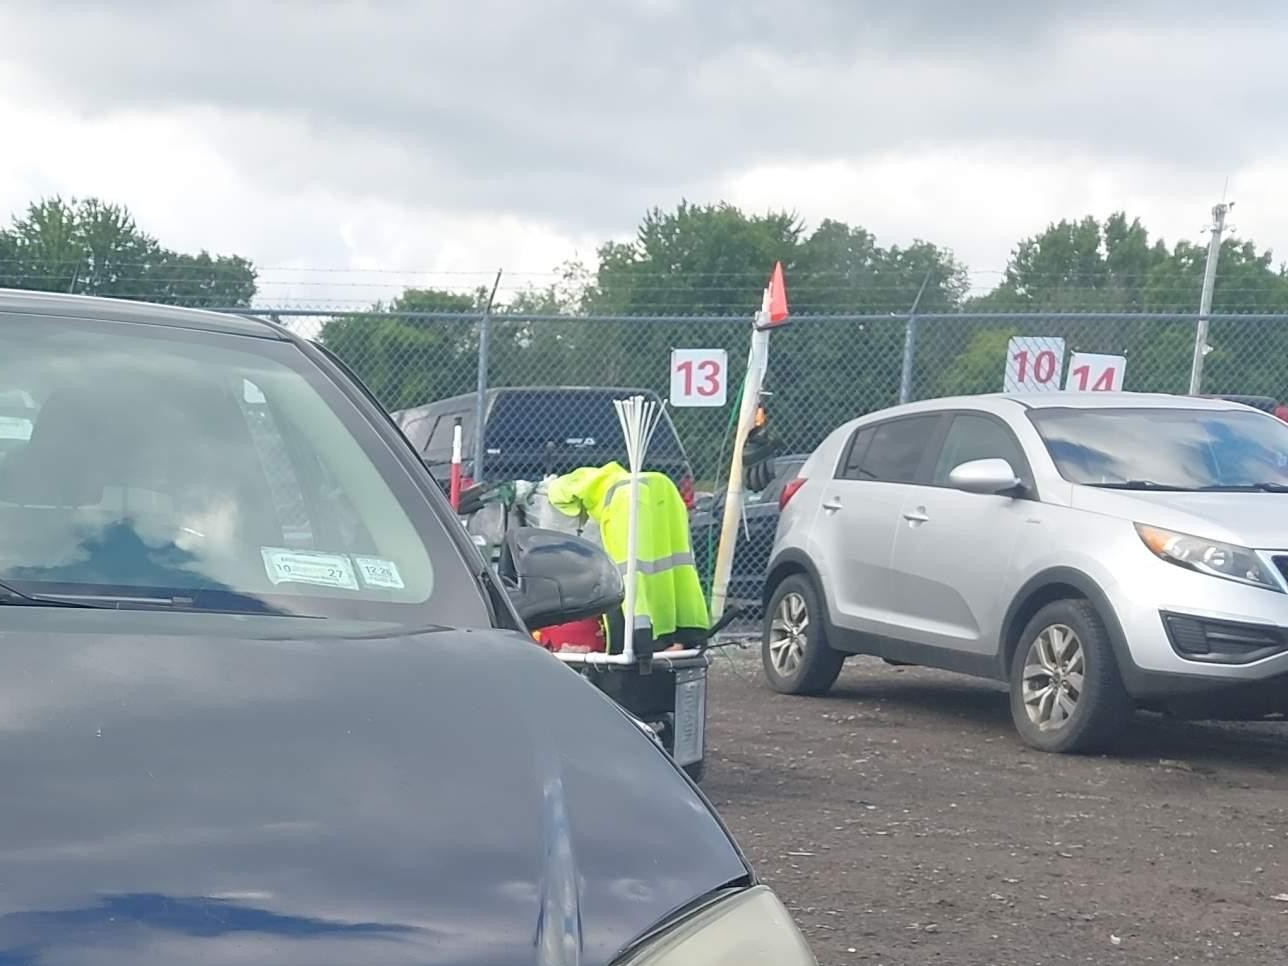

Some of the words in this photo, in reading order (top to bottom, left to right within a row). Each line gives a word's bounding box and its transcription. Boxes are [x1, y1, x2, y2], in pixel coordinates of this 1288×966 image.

[676, 359, 721, 397] 13
[1014, 350, 1056, 384] 10
[1073, 365, 1117, 392] 14
